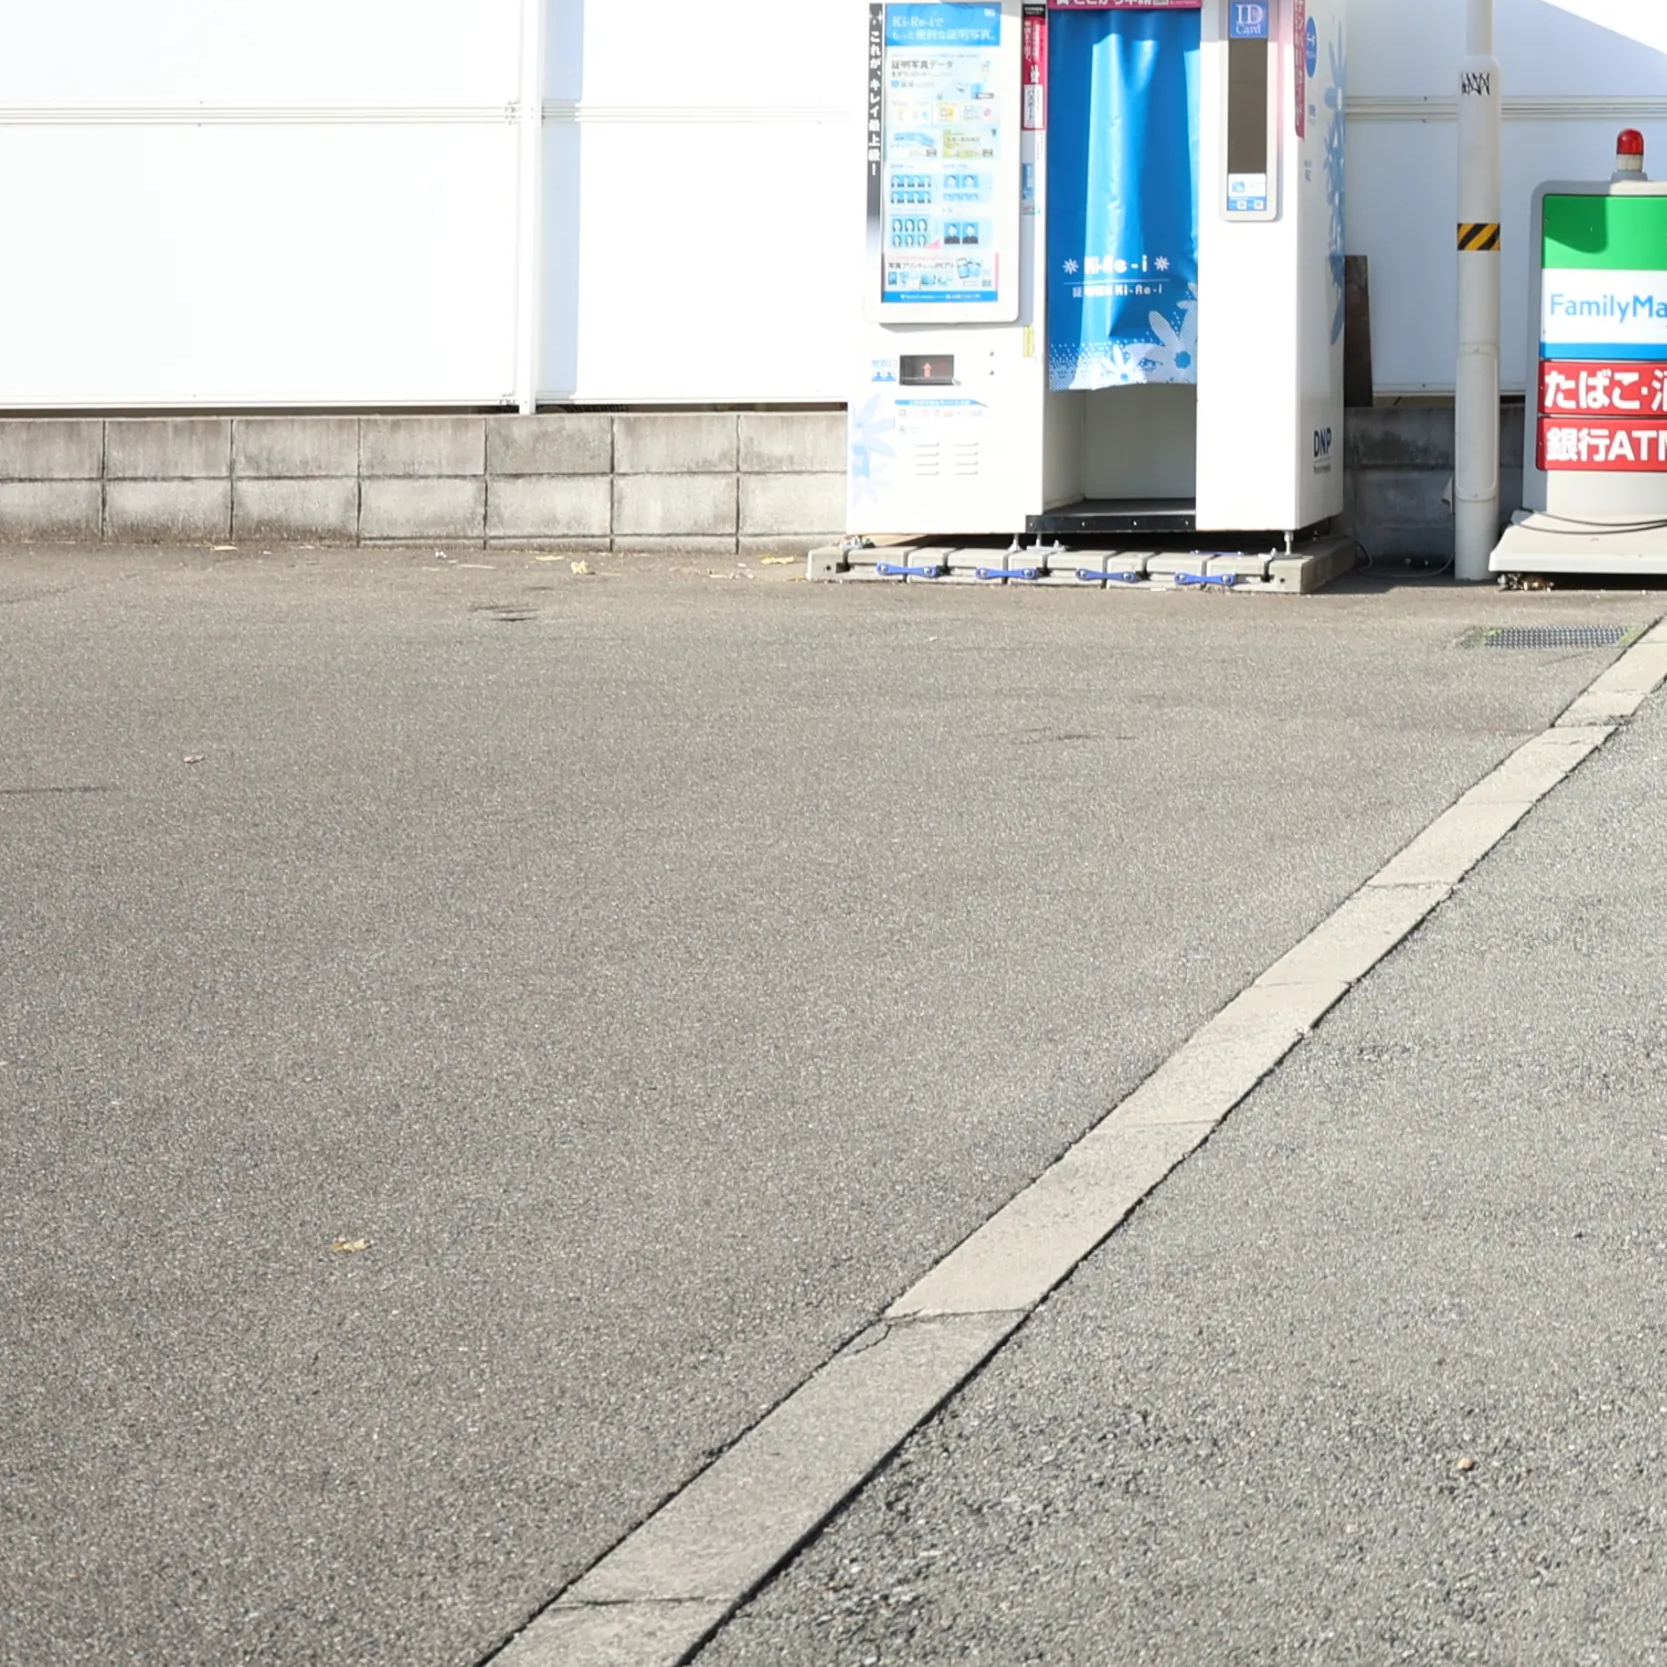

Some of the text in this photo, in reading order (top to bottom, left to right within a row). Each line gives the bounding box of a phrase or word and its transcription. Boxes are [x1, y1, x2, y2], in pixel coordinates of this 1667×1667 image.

[1236, 4, 1263, 24] ID
[1235, 23, 1261, 35] Card
[1313, 428, 1332, 457] DNP
